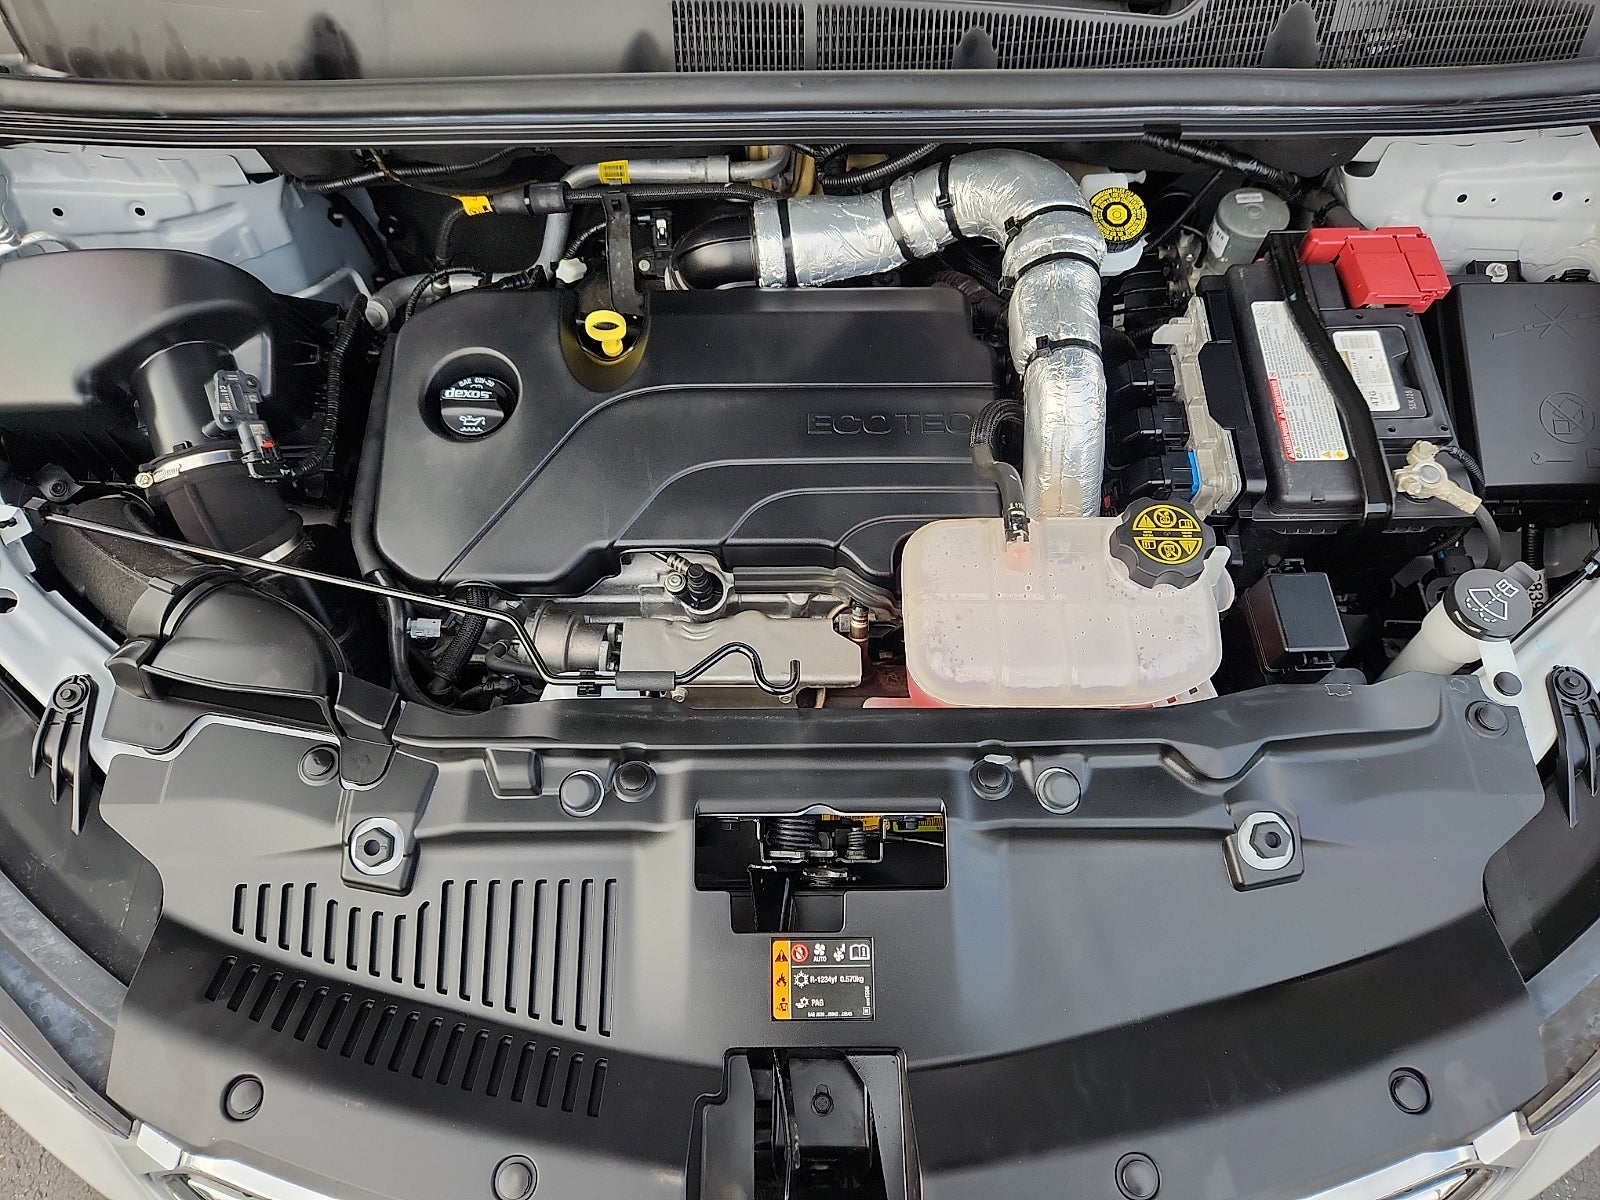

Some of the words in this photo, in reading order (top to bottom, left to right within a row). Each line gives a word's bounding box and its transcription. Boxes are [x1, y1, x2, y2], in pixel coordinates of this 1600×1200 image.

[445, 387, 492, 398] dexos
[806, 411, 971, 435] ECOTEC
[810, 976, 837, 985] R-1234yf
[840, 975, 865, 984] 0.570kg
[811, 999, 824, 1007] PAG
